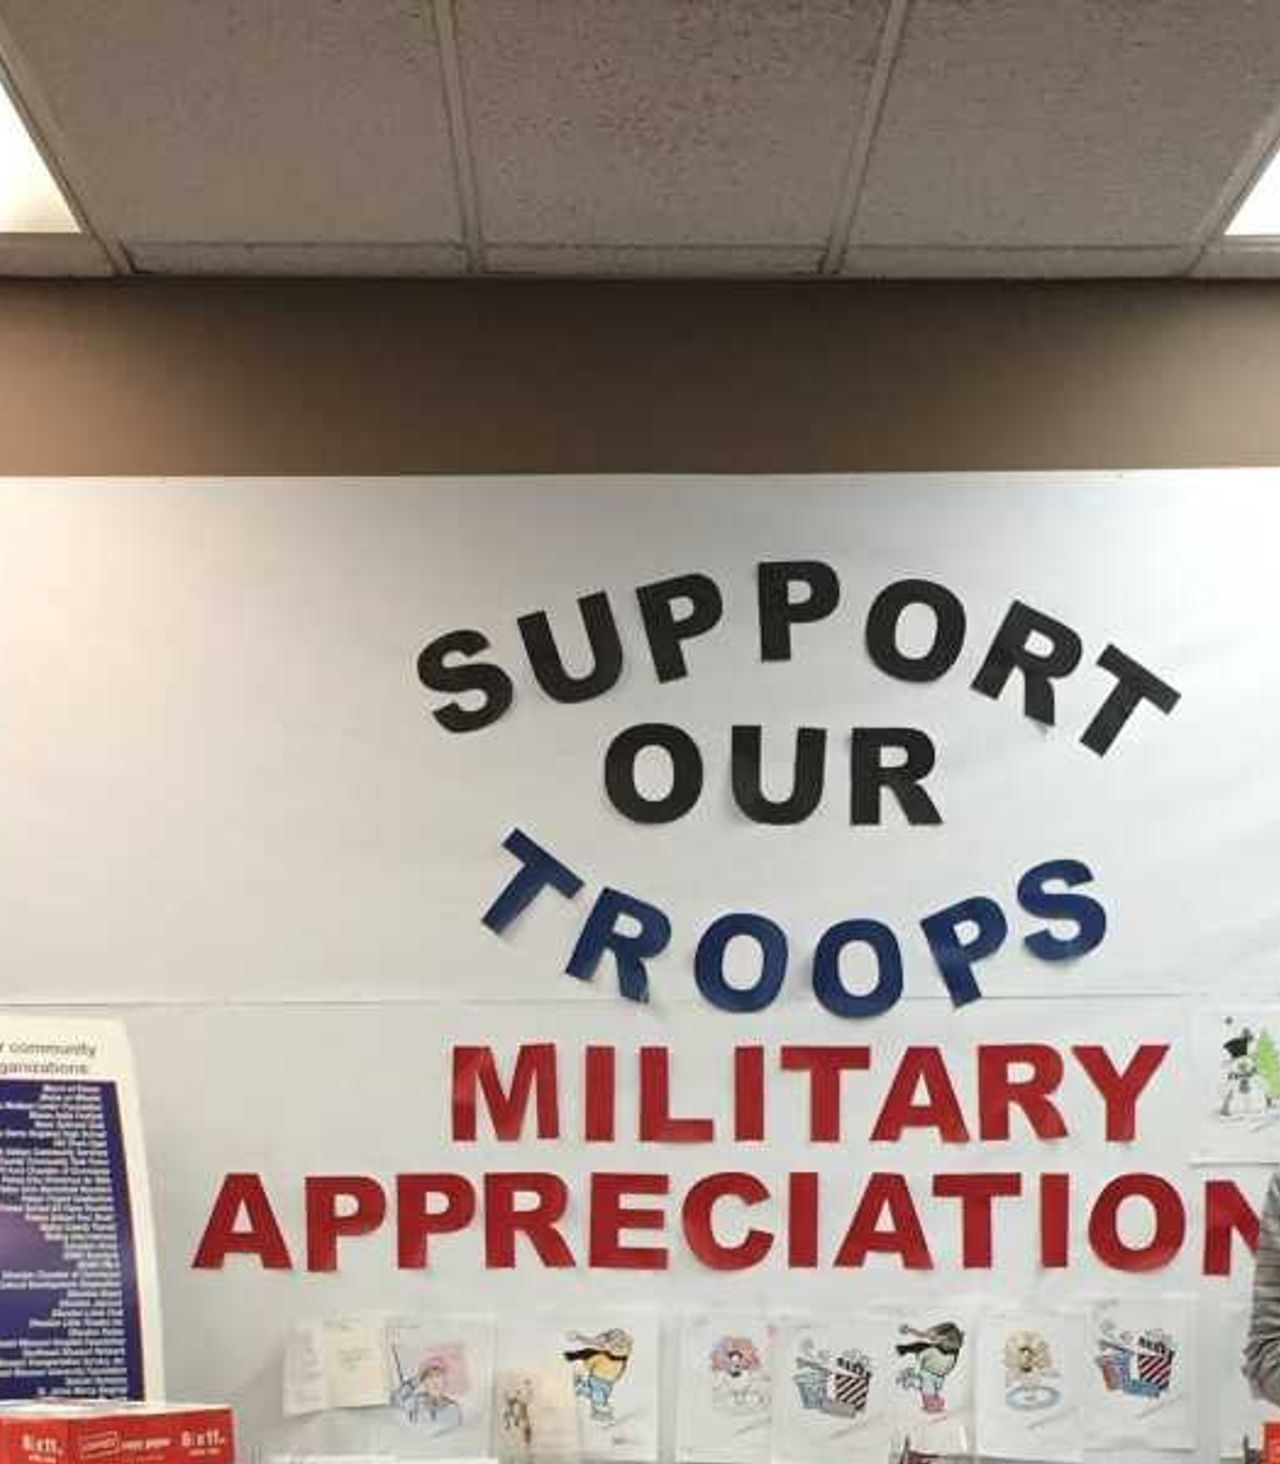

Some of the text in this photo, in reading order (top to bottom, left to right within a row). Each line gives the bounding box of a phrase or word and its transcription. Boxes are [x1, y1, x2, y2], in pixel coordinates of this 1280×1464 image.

[417, 560, 1181, 757] SUPPORT
[604, 723, 943, 825] OUR
[481, 828, 1108, 1019] TROOPS
[9, 1042, 96, 1057] community
[452, 1041, 1170, 1144] MILITARY
[194, 1171, 1261, 1276] APPRECIATION
